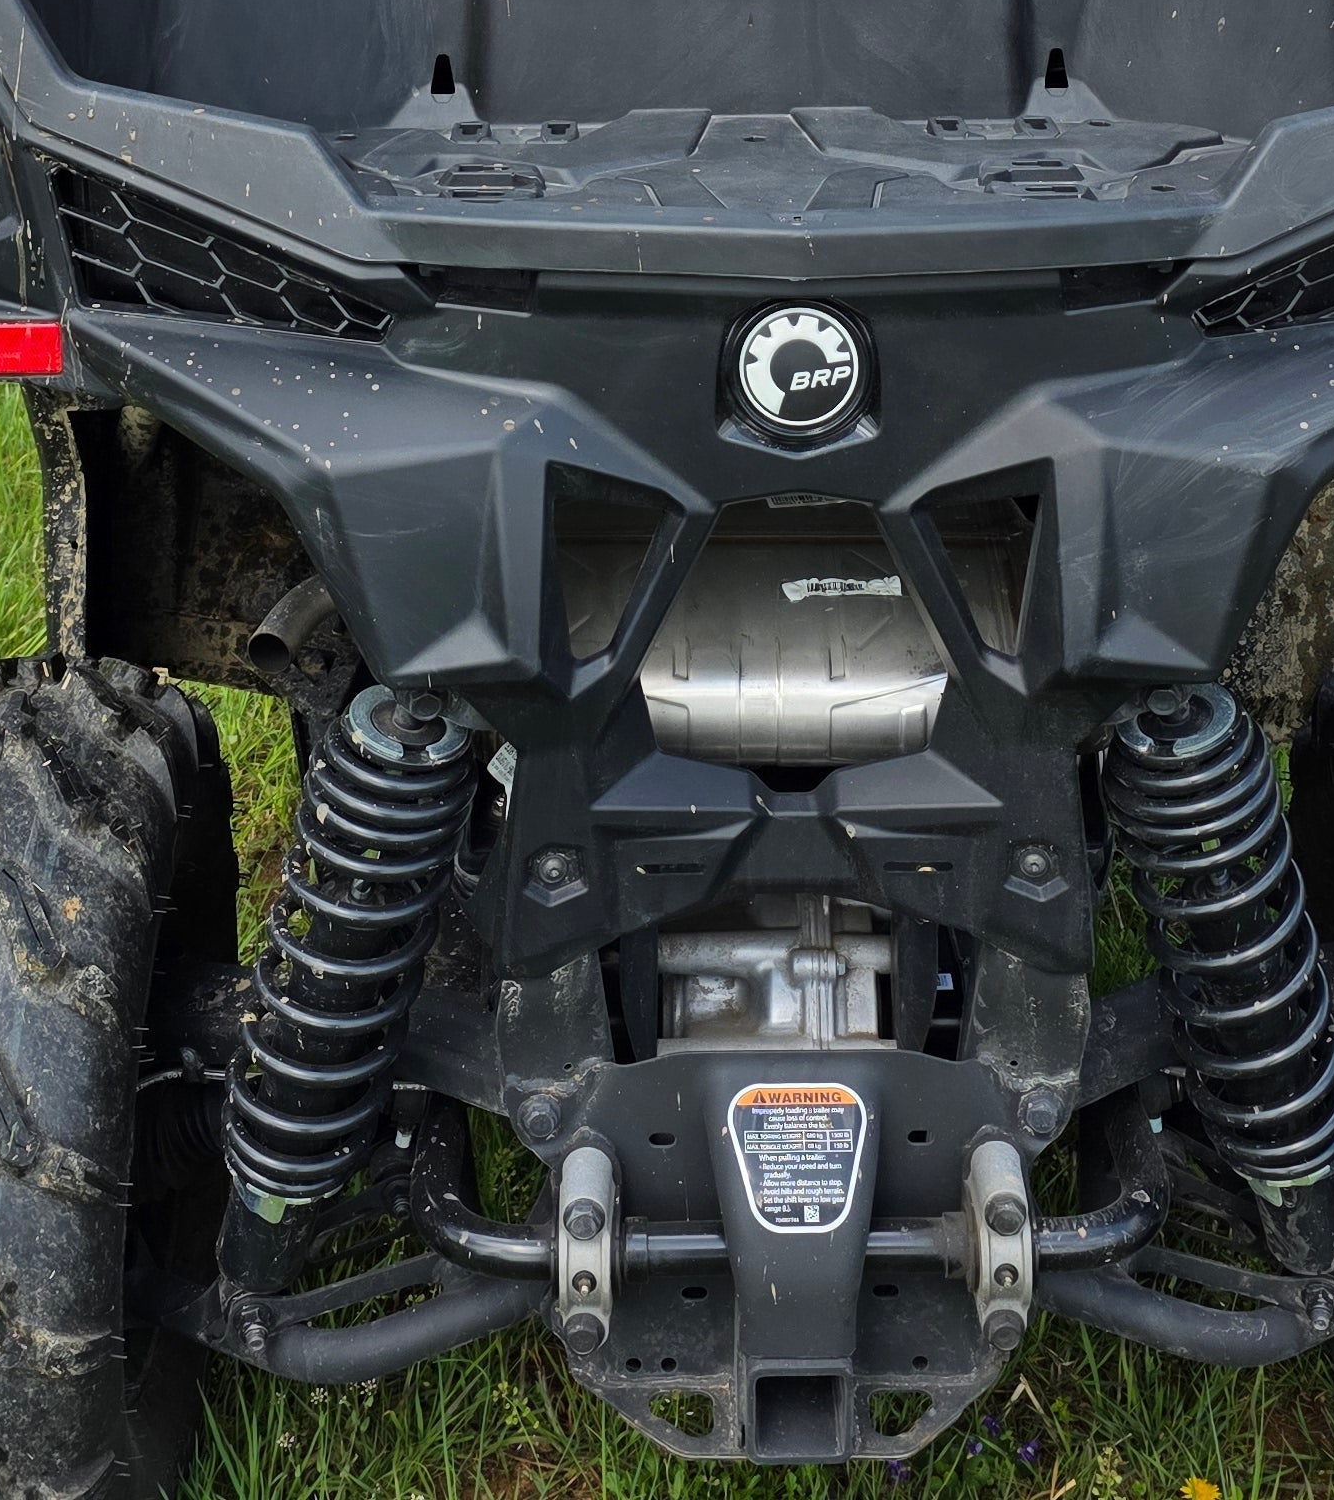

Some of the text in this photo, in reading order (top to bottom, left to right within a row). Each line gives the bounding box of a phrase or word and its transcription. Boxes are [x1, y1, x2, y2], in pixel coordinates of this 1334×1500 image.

[790, 366, 851, 390] BRP
[768, 1092, 842, 1103] WARNING
[752, 1107, 784, 1115] Improperly
[764, 1122, 783, 1131] Evenly
[778, 1154, 800, 1162] pulling
[806, 1188, 823, 1196] rough
